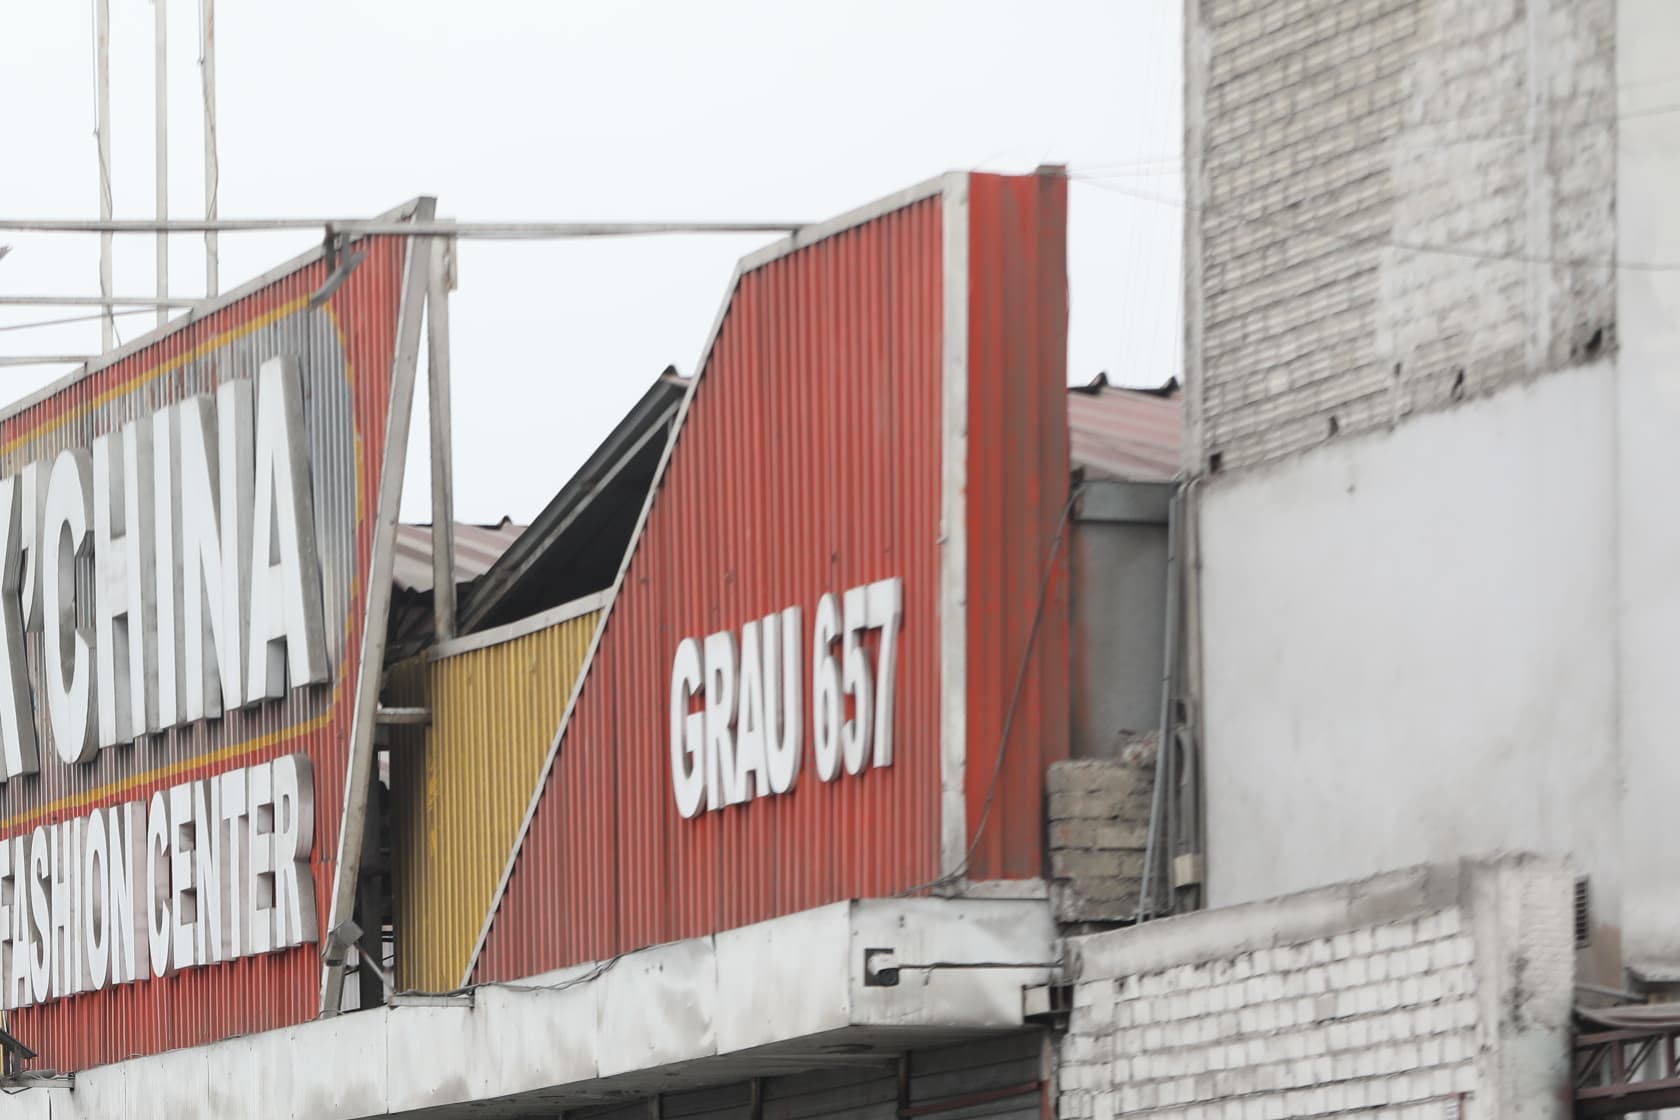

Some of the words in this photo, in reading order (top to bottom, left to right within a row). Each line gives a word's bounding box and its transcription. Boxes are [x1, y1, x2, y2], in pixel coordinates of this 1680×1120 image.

[670, 605, 803, 820] GRAU
[813, 576, 903, 783] 657
[147, 753, 317, 979] CENTER
